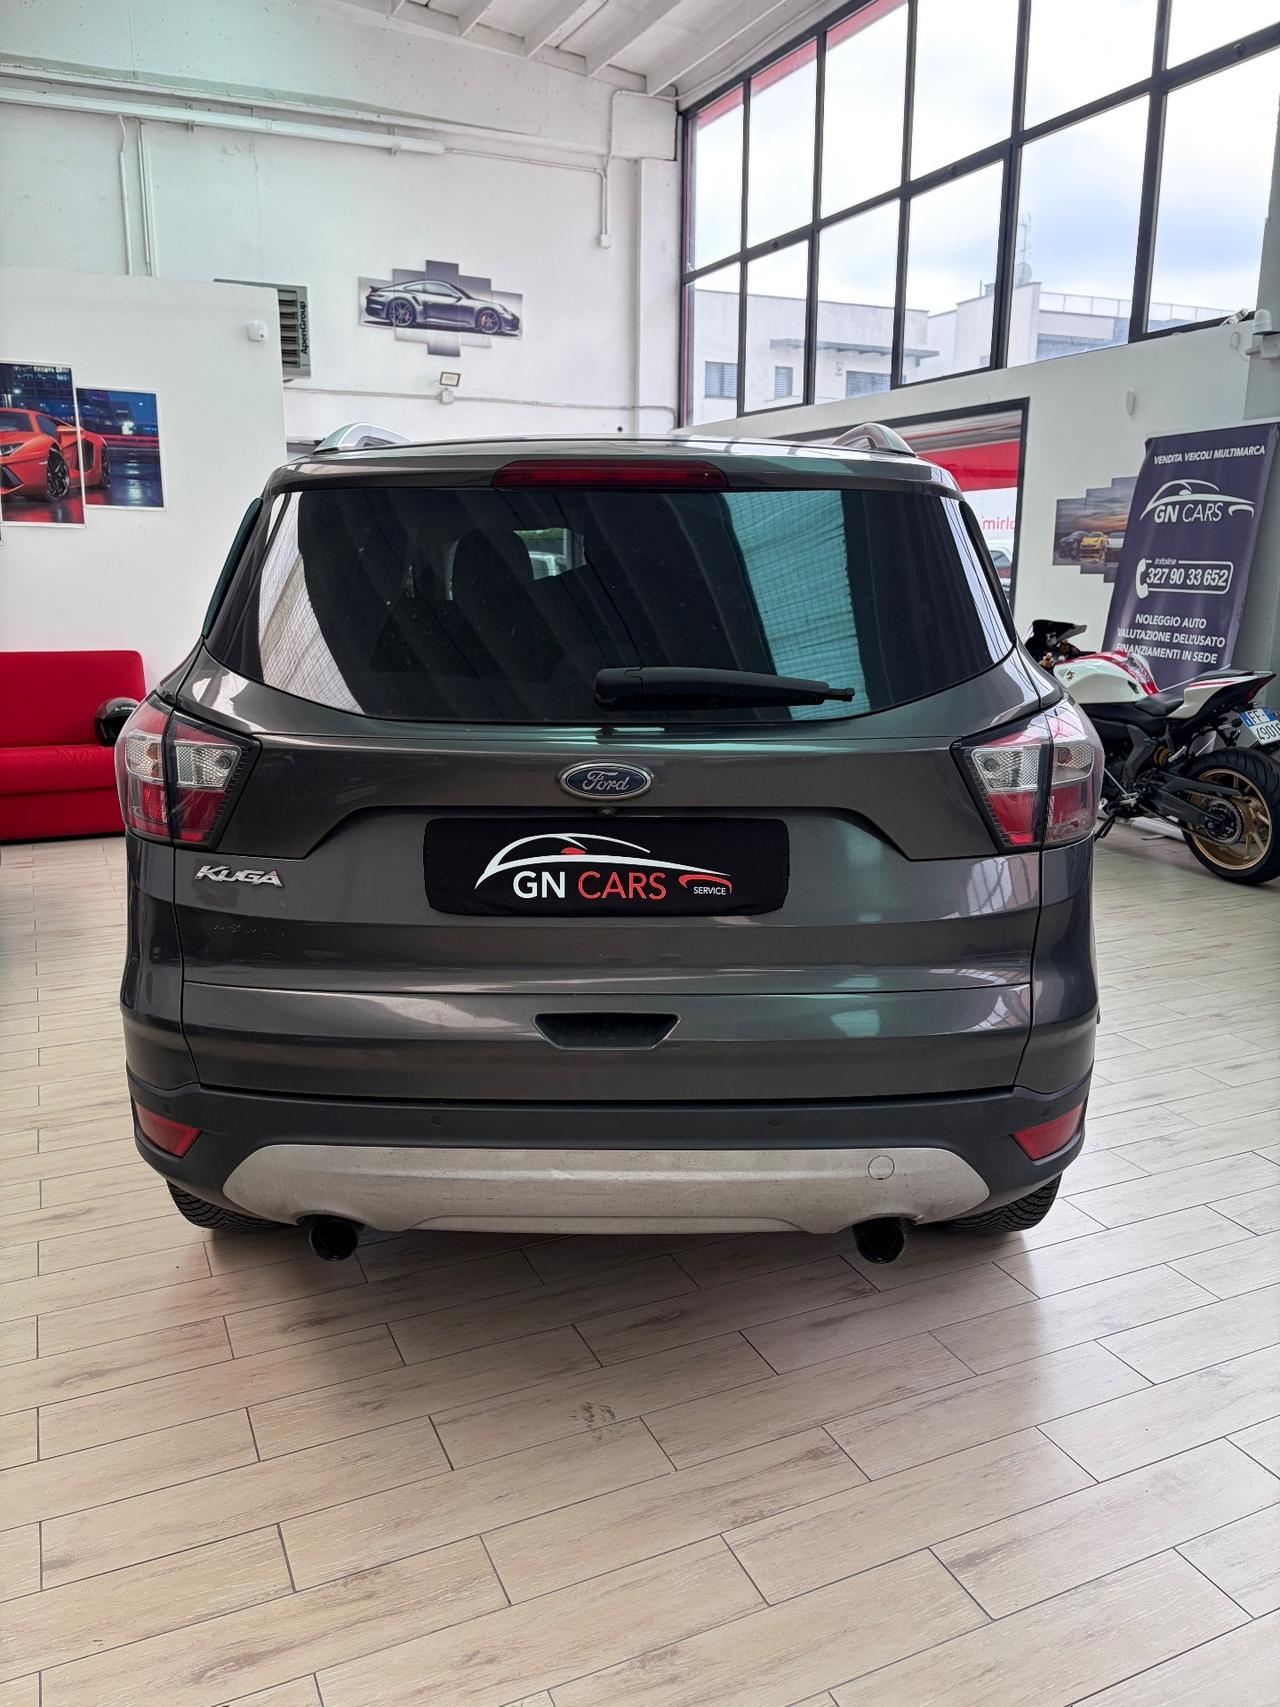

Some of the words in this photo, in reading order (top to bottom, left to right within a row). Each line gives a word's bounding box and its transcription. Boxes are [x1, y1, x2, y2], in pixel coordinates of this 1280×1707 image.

[300, 300, 309, 355] ApenGroup
[1154, 454, 1182, 464] VENDITA
[1185, 450, 1212, 461] VEICOLI
[1214, 445, 1265, 459] MULTIMARCA
[1154, 505, 1179, 523] GN
[1182, 502, 1223, 522] CARS
[1146, 567, 1169, 584] 327
[1169, 568, 1185, 584] 90
[1186, 568, 1203, 585] 33
[1203, 569, 1229, 586] 652
[1135, 613, 1181, 628] NOLEGGIO
[1181, 617, 1207, 629] AUTO
[1117, 627, 1171, 642] VALUTAZIONE
[1181, 652, 1191, 661] IN
[1192, 651, 1218, 664] SEDE
[582, 770, 629, 792] Ford
[194, 865, 285, 888] KUGA
[512, 870, 566, 899] GN
[577, 870, 667, 900] CARS
[692, 885, 727, 896] SERVICE
